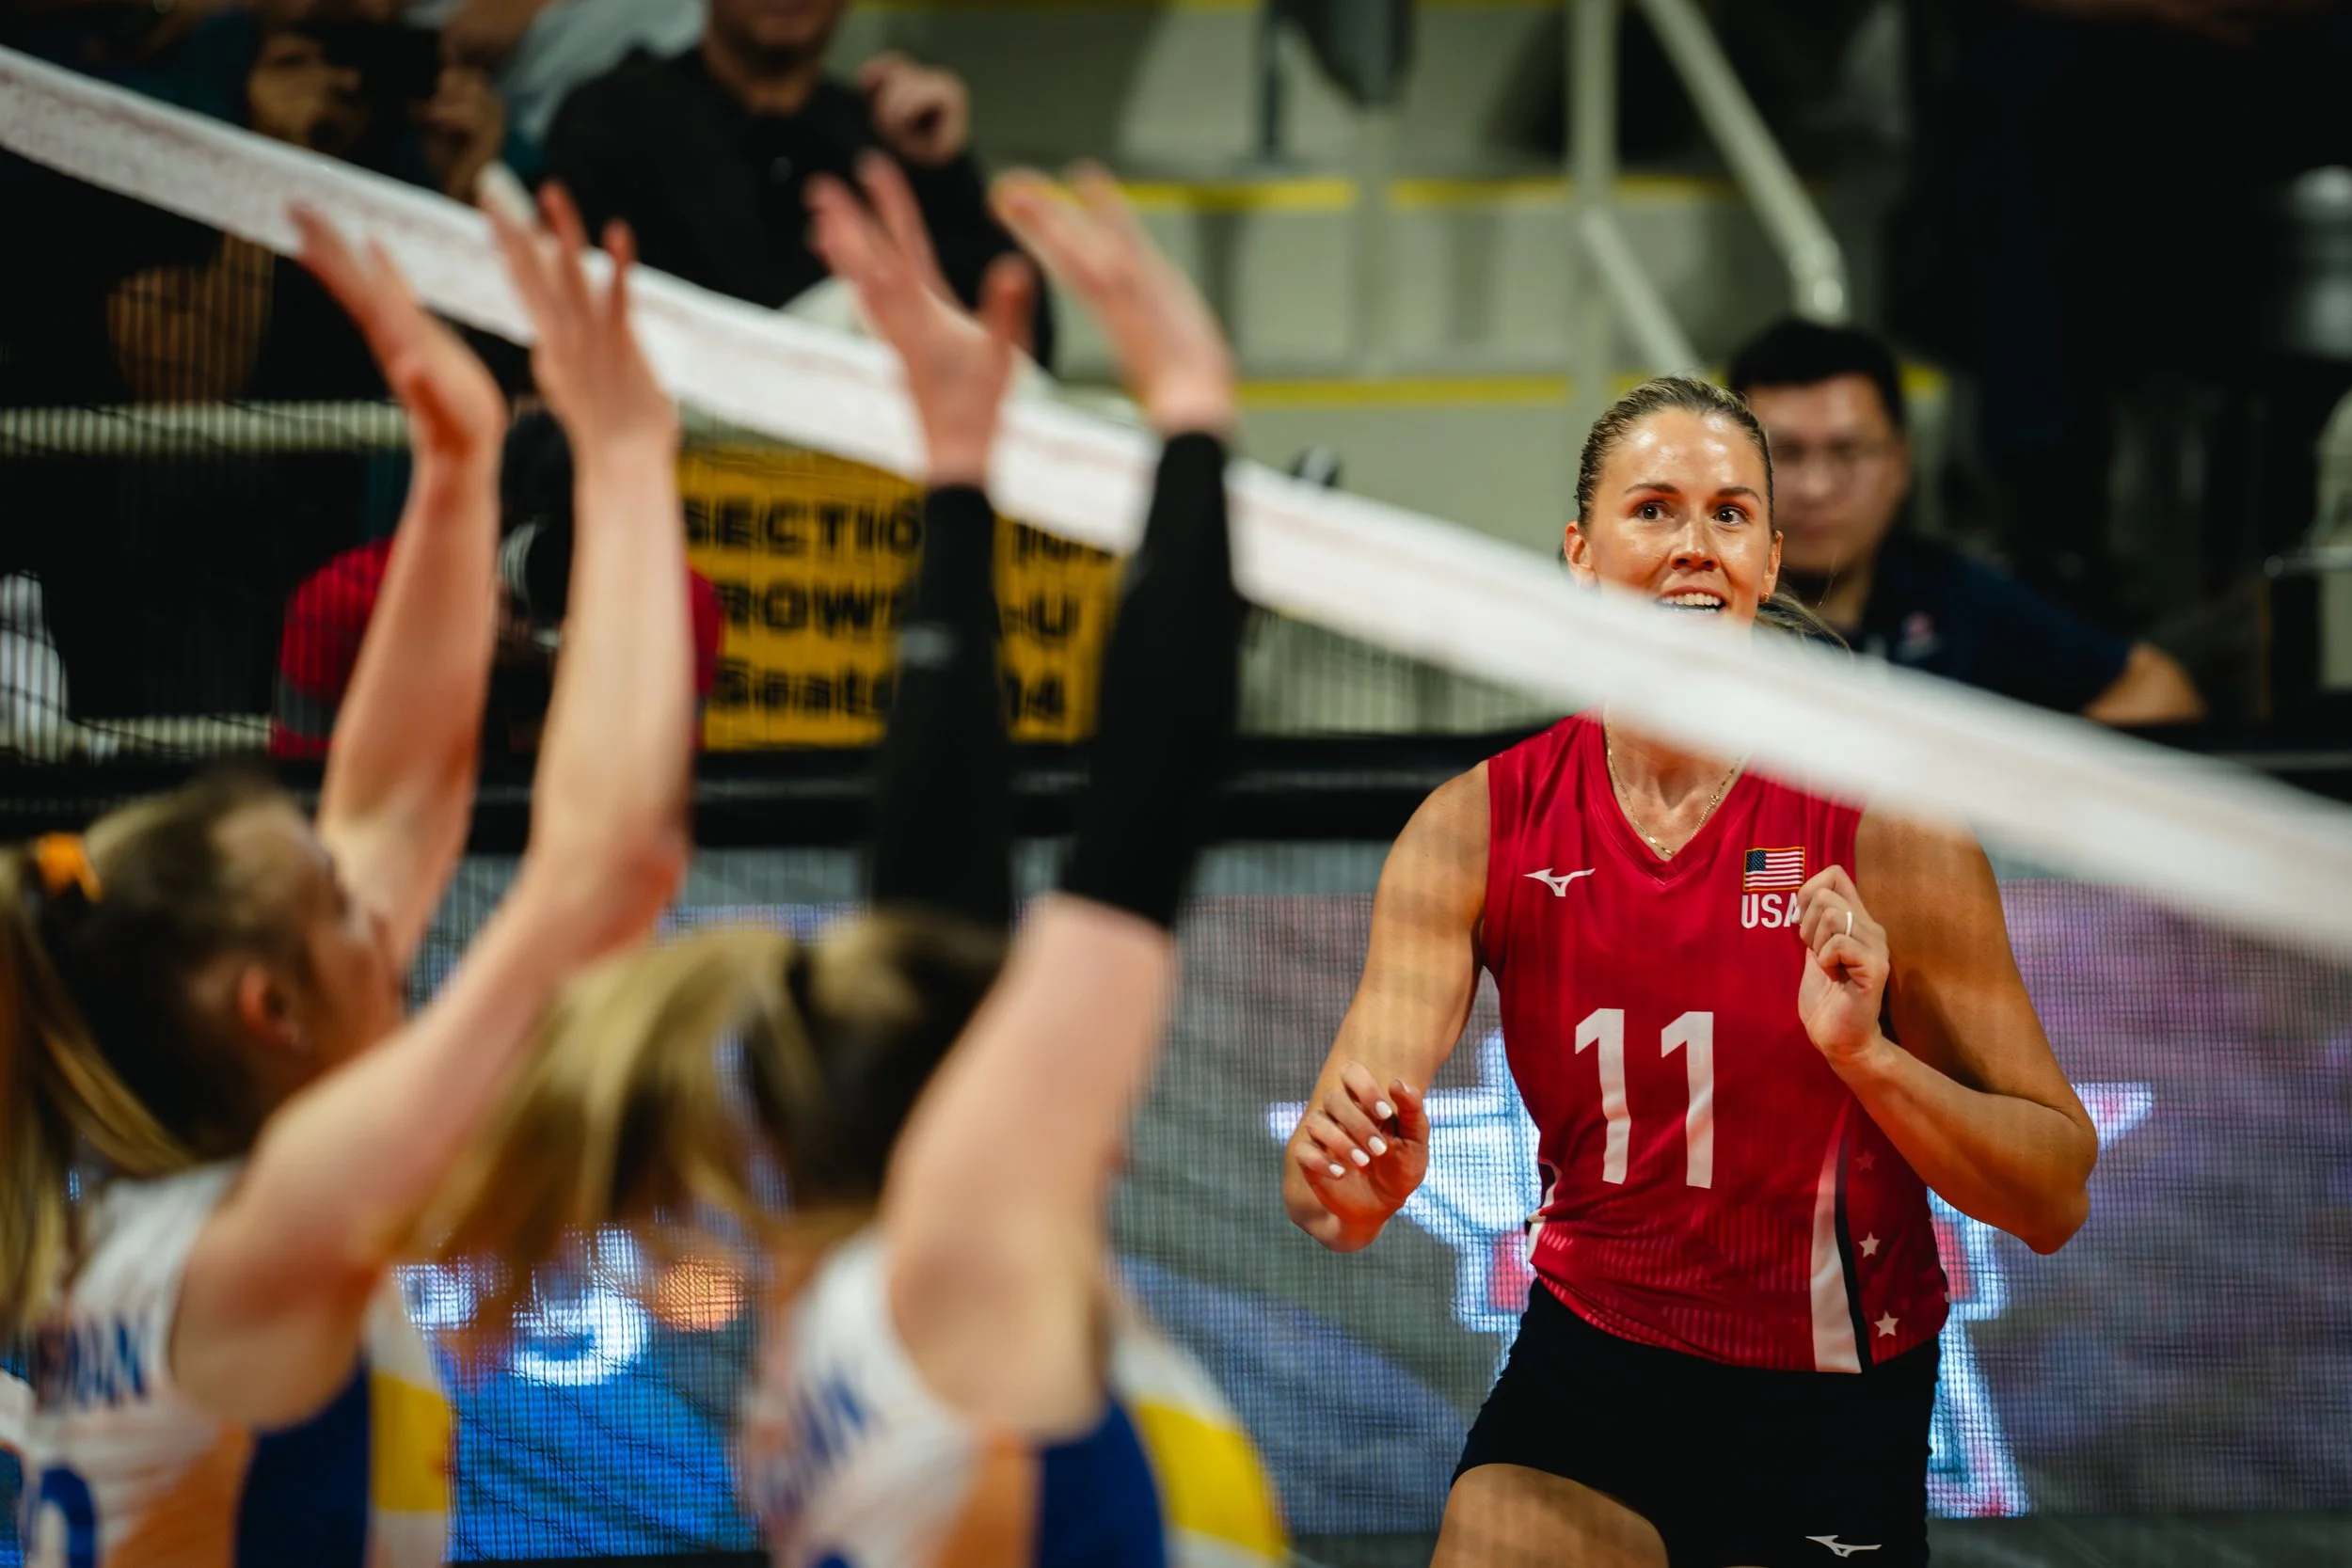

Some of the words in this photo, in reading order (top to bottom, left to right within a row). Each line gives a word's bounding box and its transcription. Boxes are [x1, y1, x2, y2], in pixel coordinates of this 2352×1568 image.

[681, 497, 926, 560] SECTIO
[712, 656, 889, 719] Seat
[1575, 1007, 1714, 1189] 11
